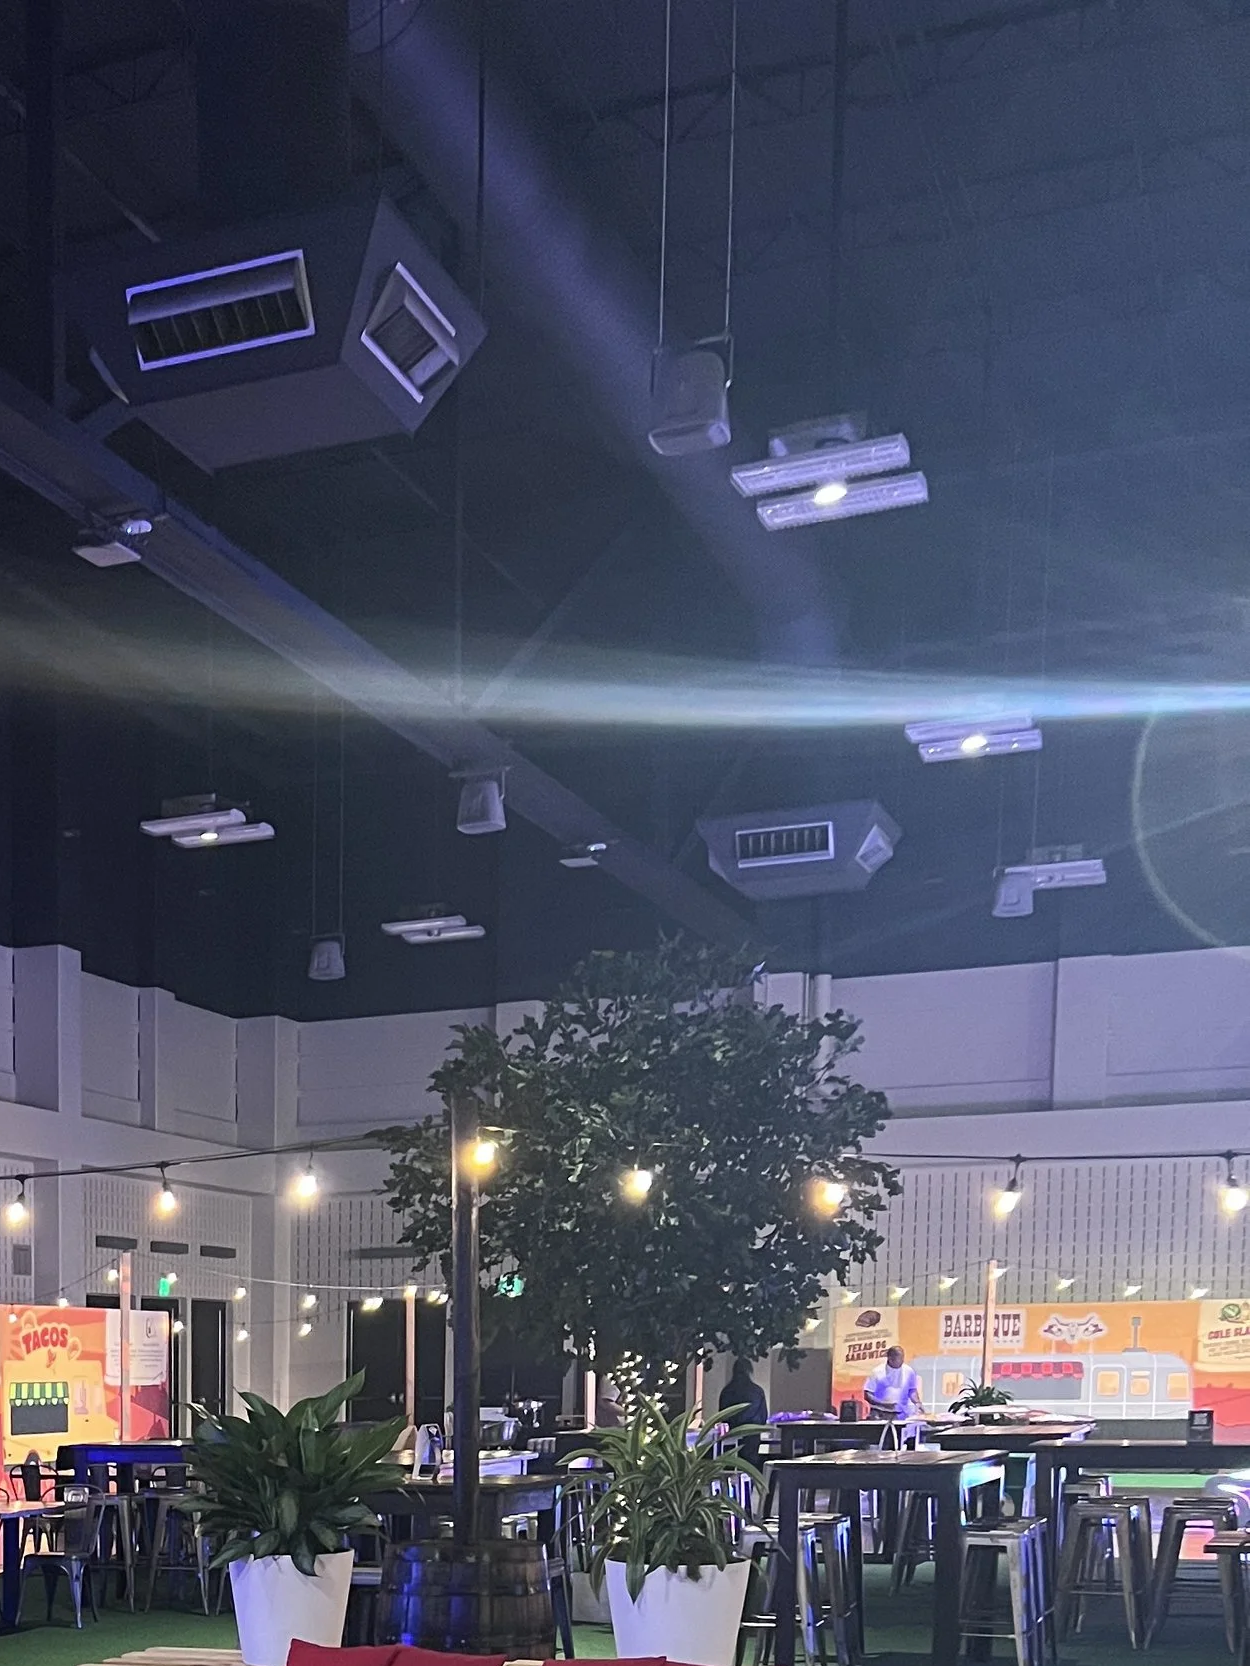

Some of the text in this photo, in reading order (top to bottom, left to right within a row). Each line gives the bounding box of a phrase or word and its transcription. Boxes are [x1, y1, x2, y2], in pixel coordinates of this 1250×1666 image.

[944, 1314, 1021, 1337] BARBQUE
[22, 1327, 68, 1354] TACOS
[848, 1342, 872, 1353] TEXAS
